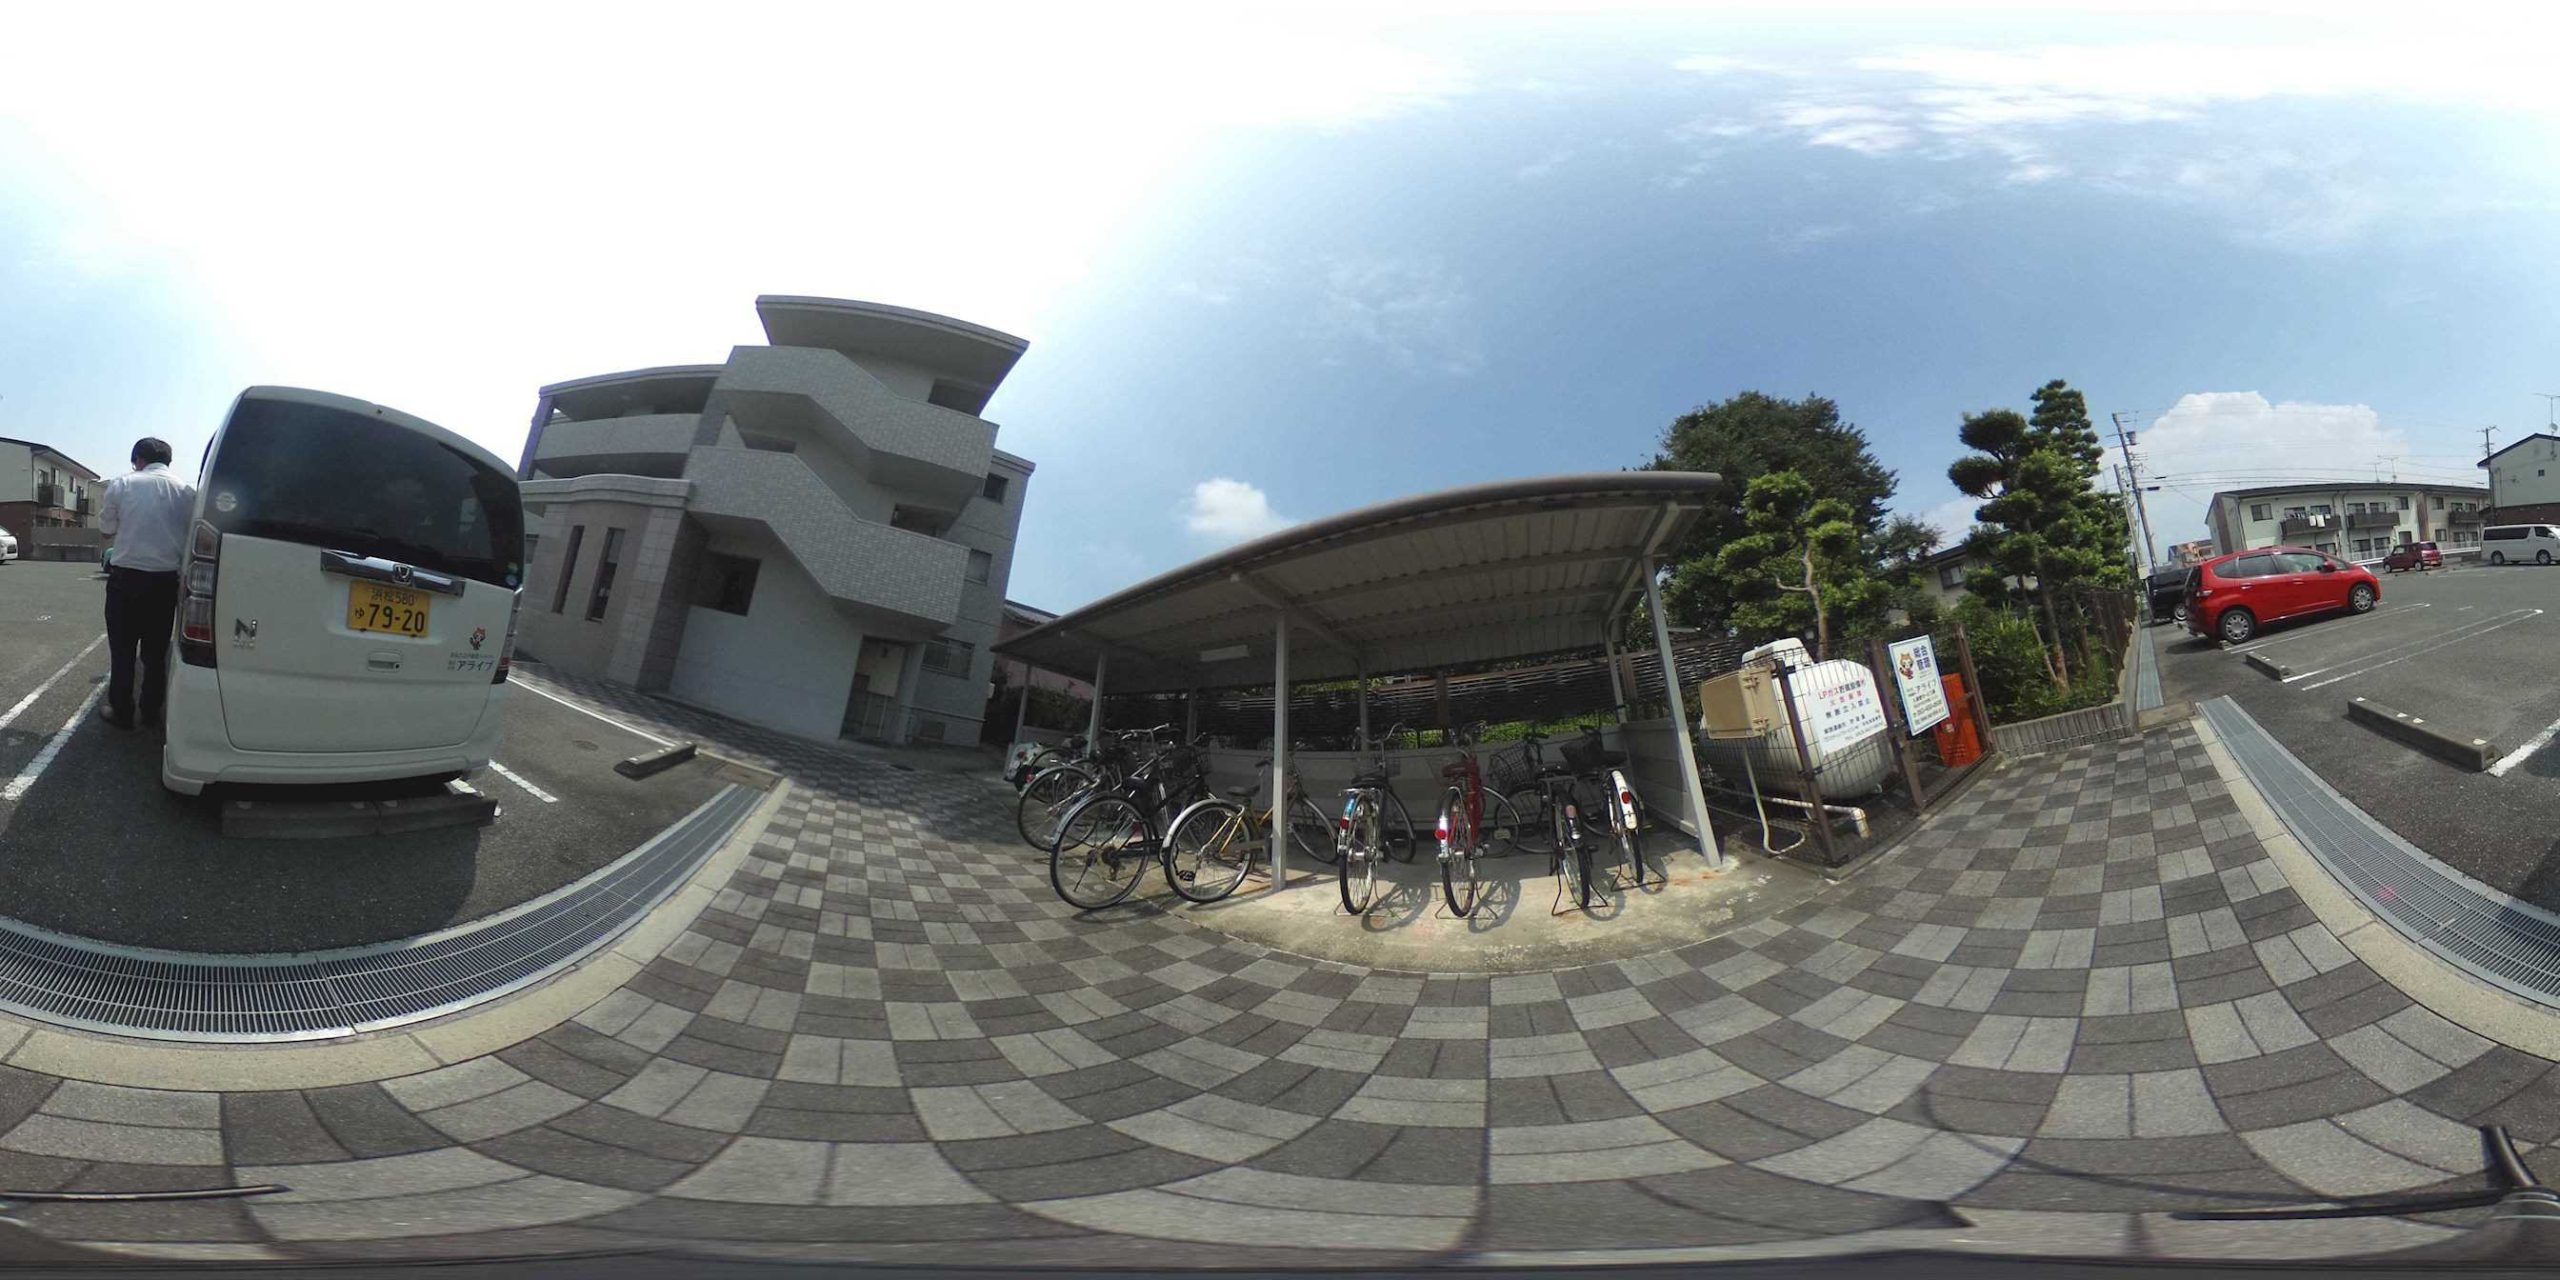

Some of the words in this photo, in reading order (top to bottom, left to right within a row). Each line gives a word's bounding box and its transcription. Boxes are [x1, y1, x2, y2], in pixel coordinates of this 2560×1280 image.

[395, 592, 415, 606] 580
[355, 607, 365, 619] ゆ
[368, 604, 425, 633] 79-20
